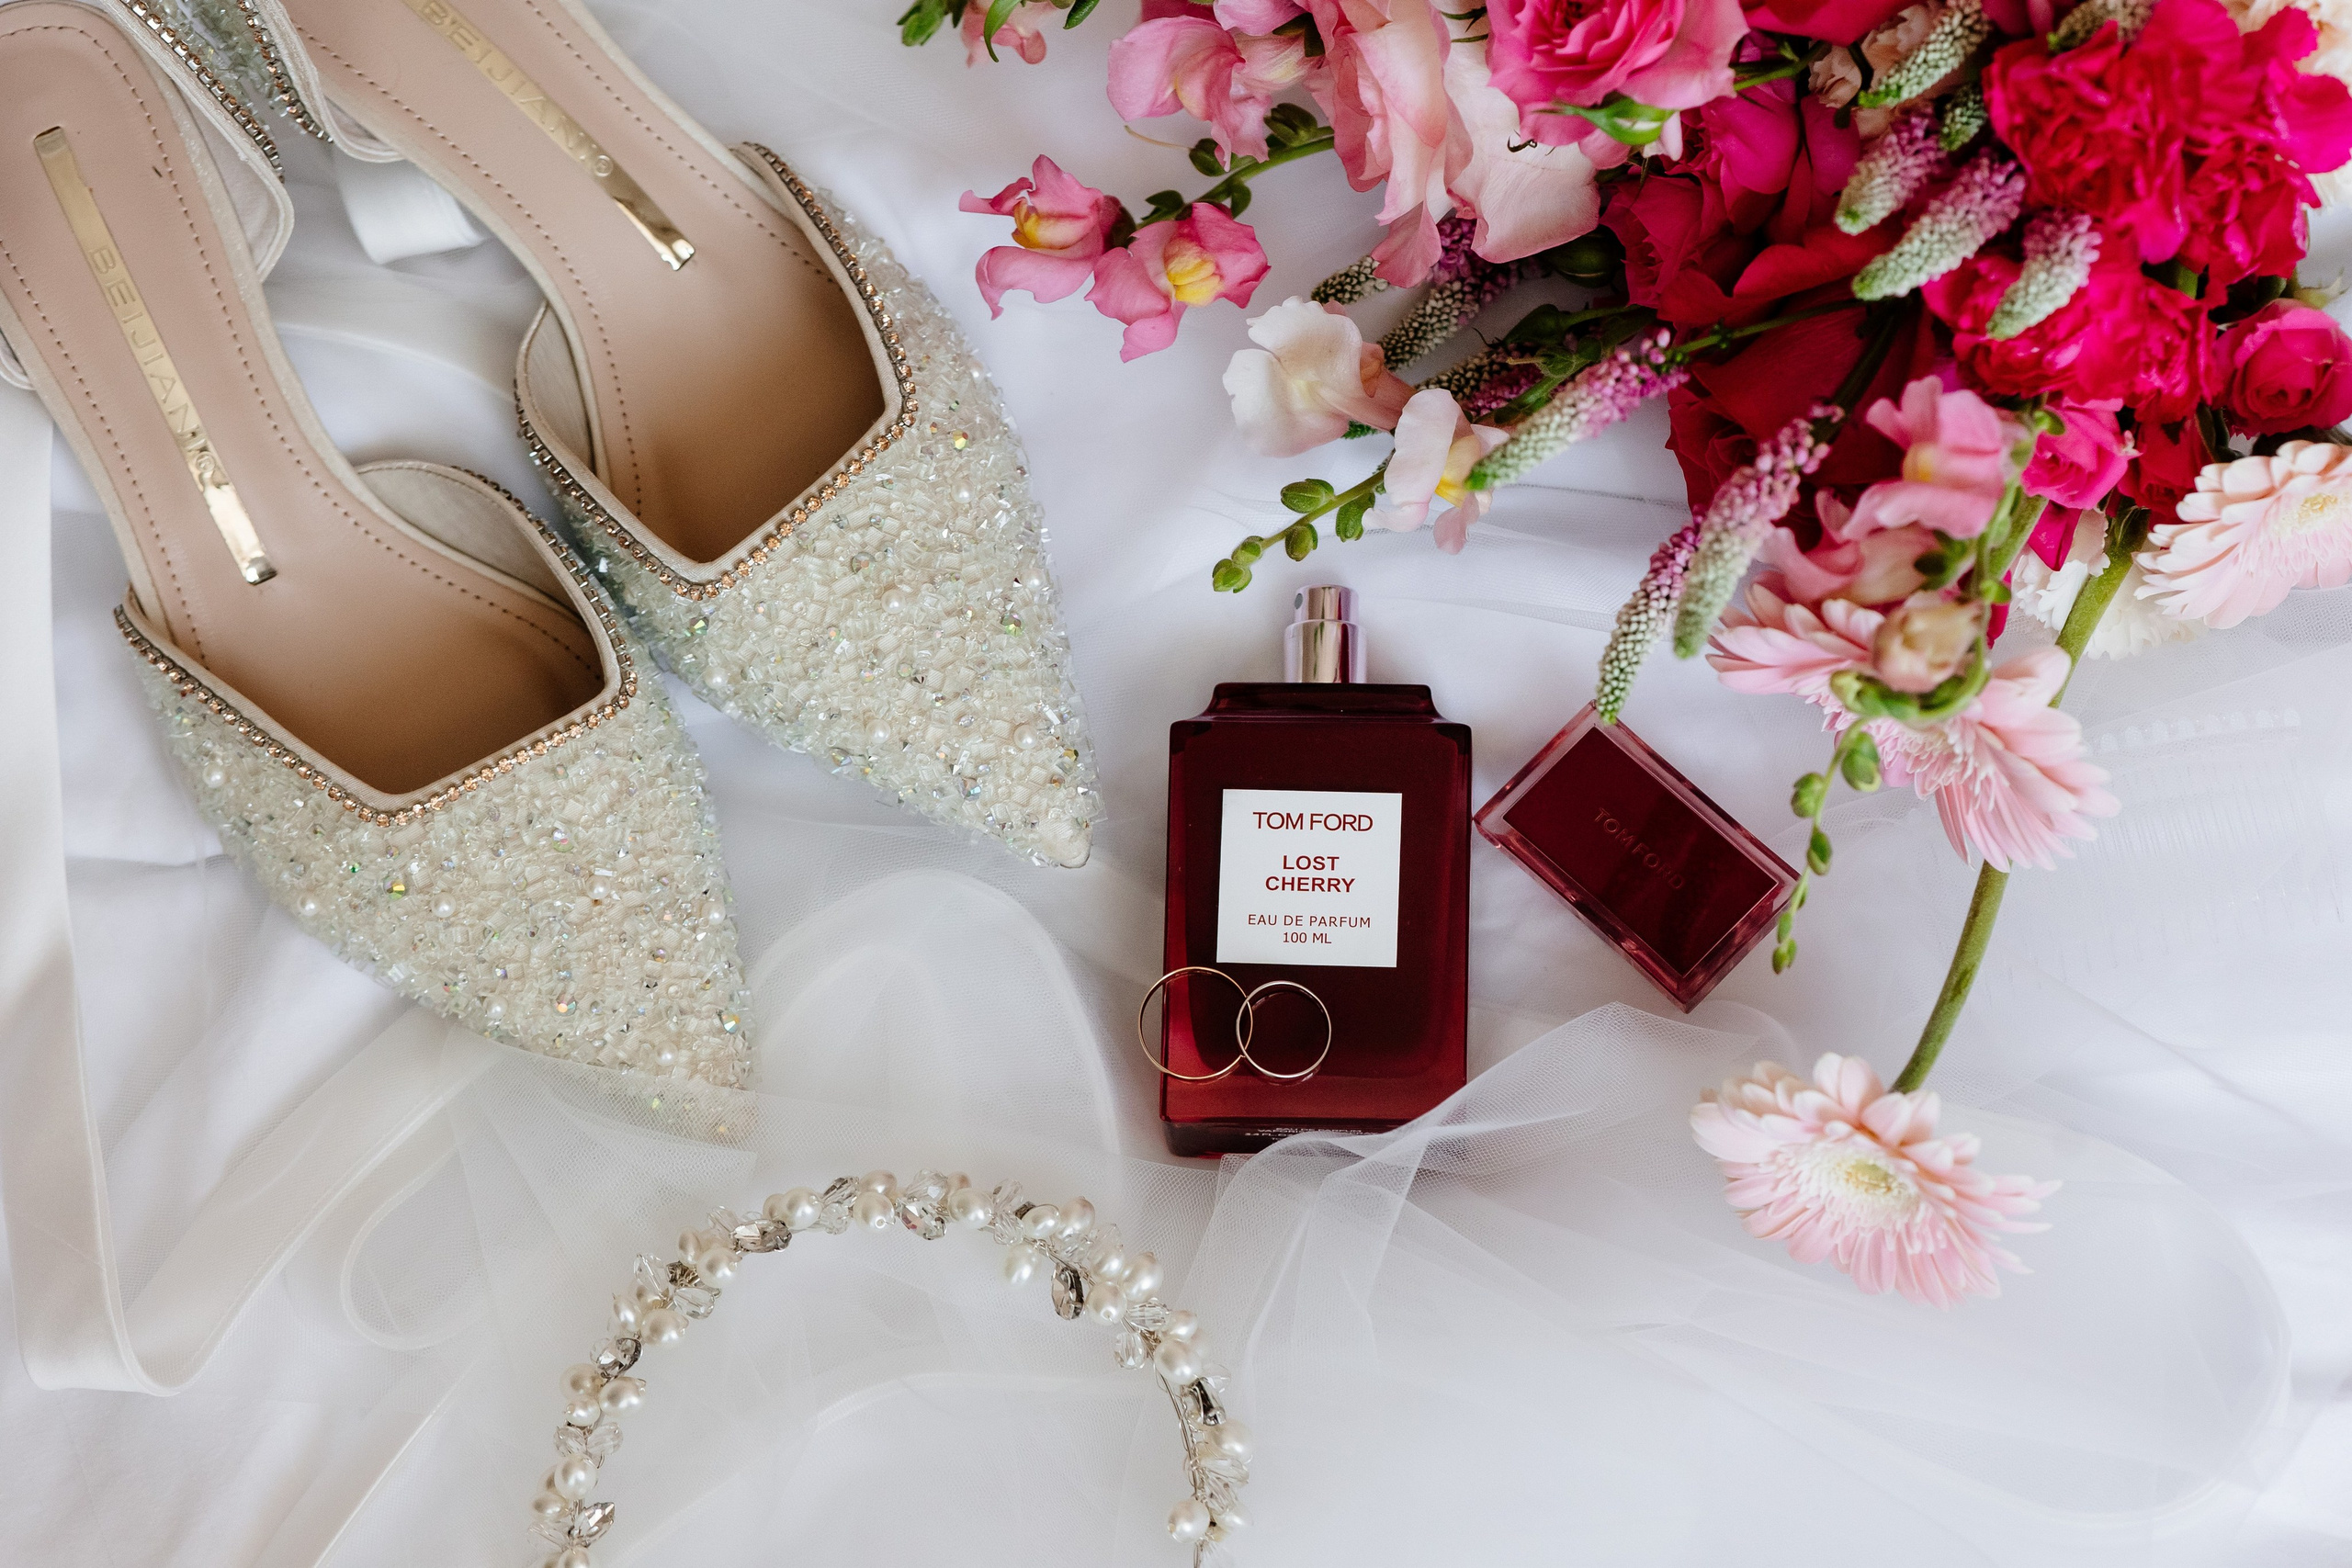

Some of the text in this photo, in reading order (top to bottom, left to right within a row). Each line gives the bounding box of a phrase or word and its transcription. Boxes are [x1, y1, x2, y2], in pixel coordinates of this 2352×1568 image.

[1252, 812, 1374, 831] TOM FORD
[1594, 807, 1685, 889] TOM FORD
[1283, 855, 1340, 871] LOST
[1265, 876, 1355, 893] CHERRY
[1248, 914, 1371, 929] EAU DE PARFUM
[1283, 931, 1332, 944] 100 ML
